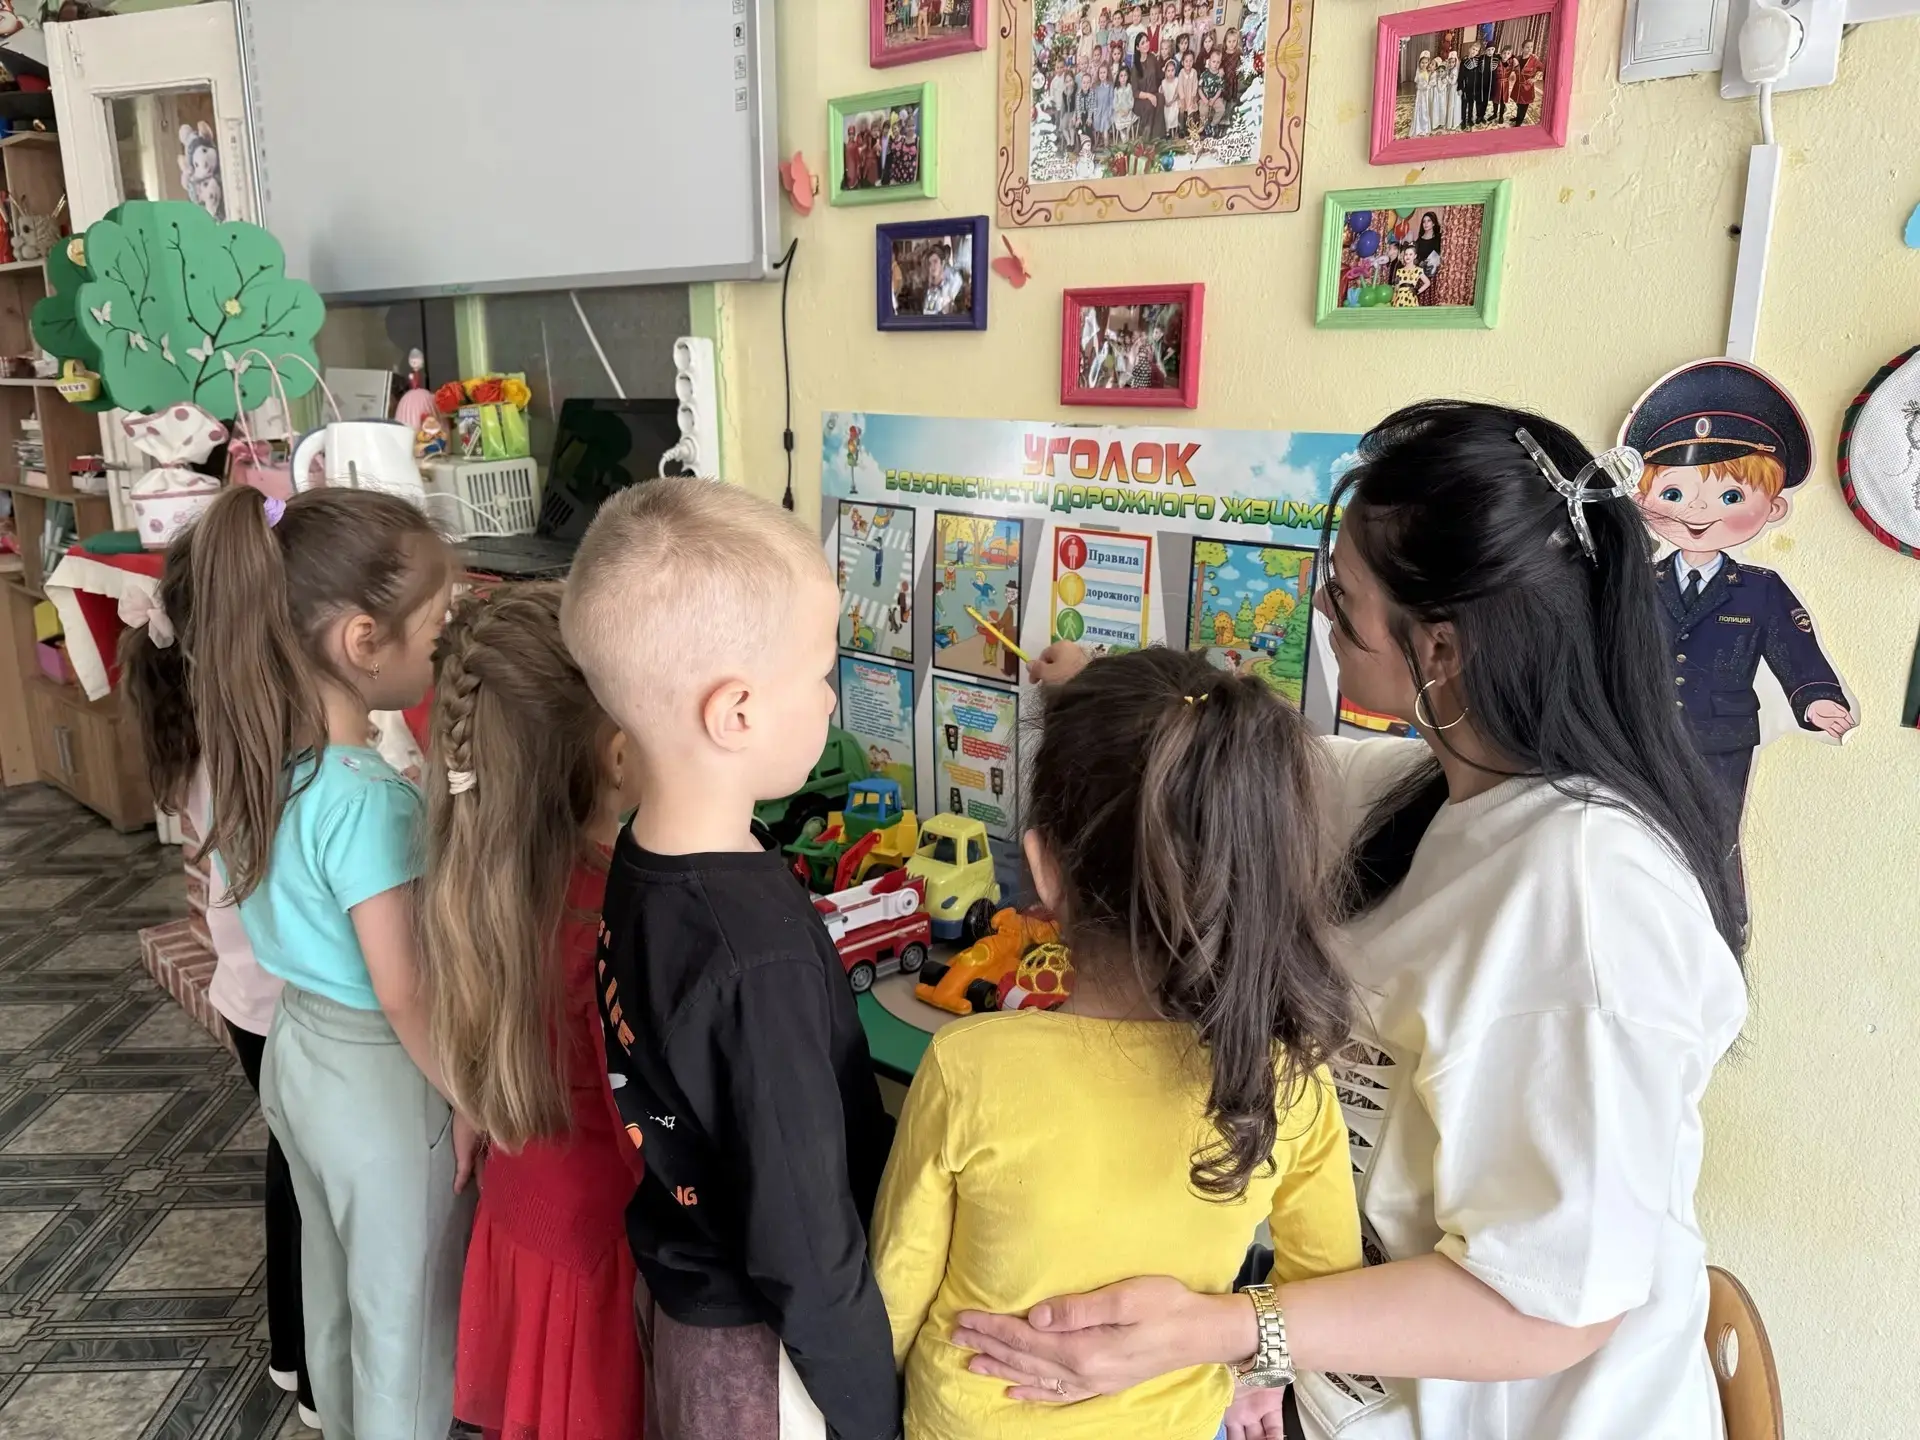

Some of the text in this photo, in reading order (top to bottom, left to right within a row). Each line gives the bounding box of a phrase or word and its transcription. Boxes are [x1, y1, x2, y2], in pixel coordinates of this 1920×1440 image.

[1023, 433, 1201, 487] УГОЛОК
[1050, 483, 1215, 520] ДОРОЖНОГО
[1220, 496, 1343, 530] ЖВИЖЕ
[1088, 548, 1139, 566] Правила
[1085, 588, 1140, 603] дорожного
[1718, 615, 1751, 624] ПОЛИЦИЯ
[1085, 624, 1136, 641] движения
